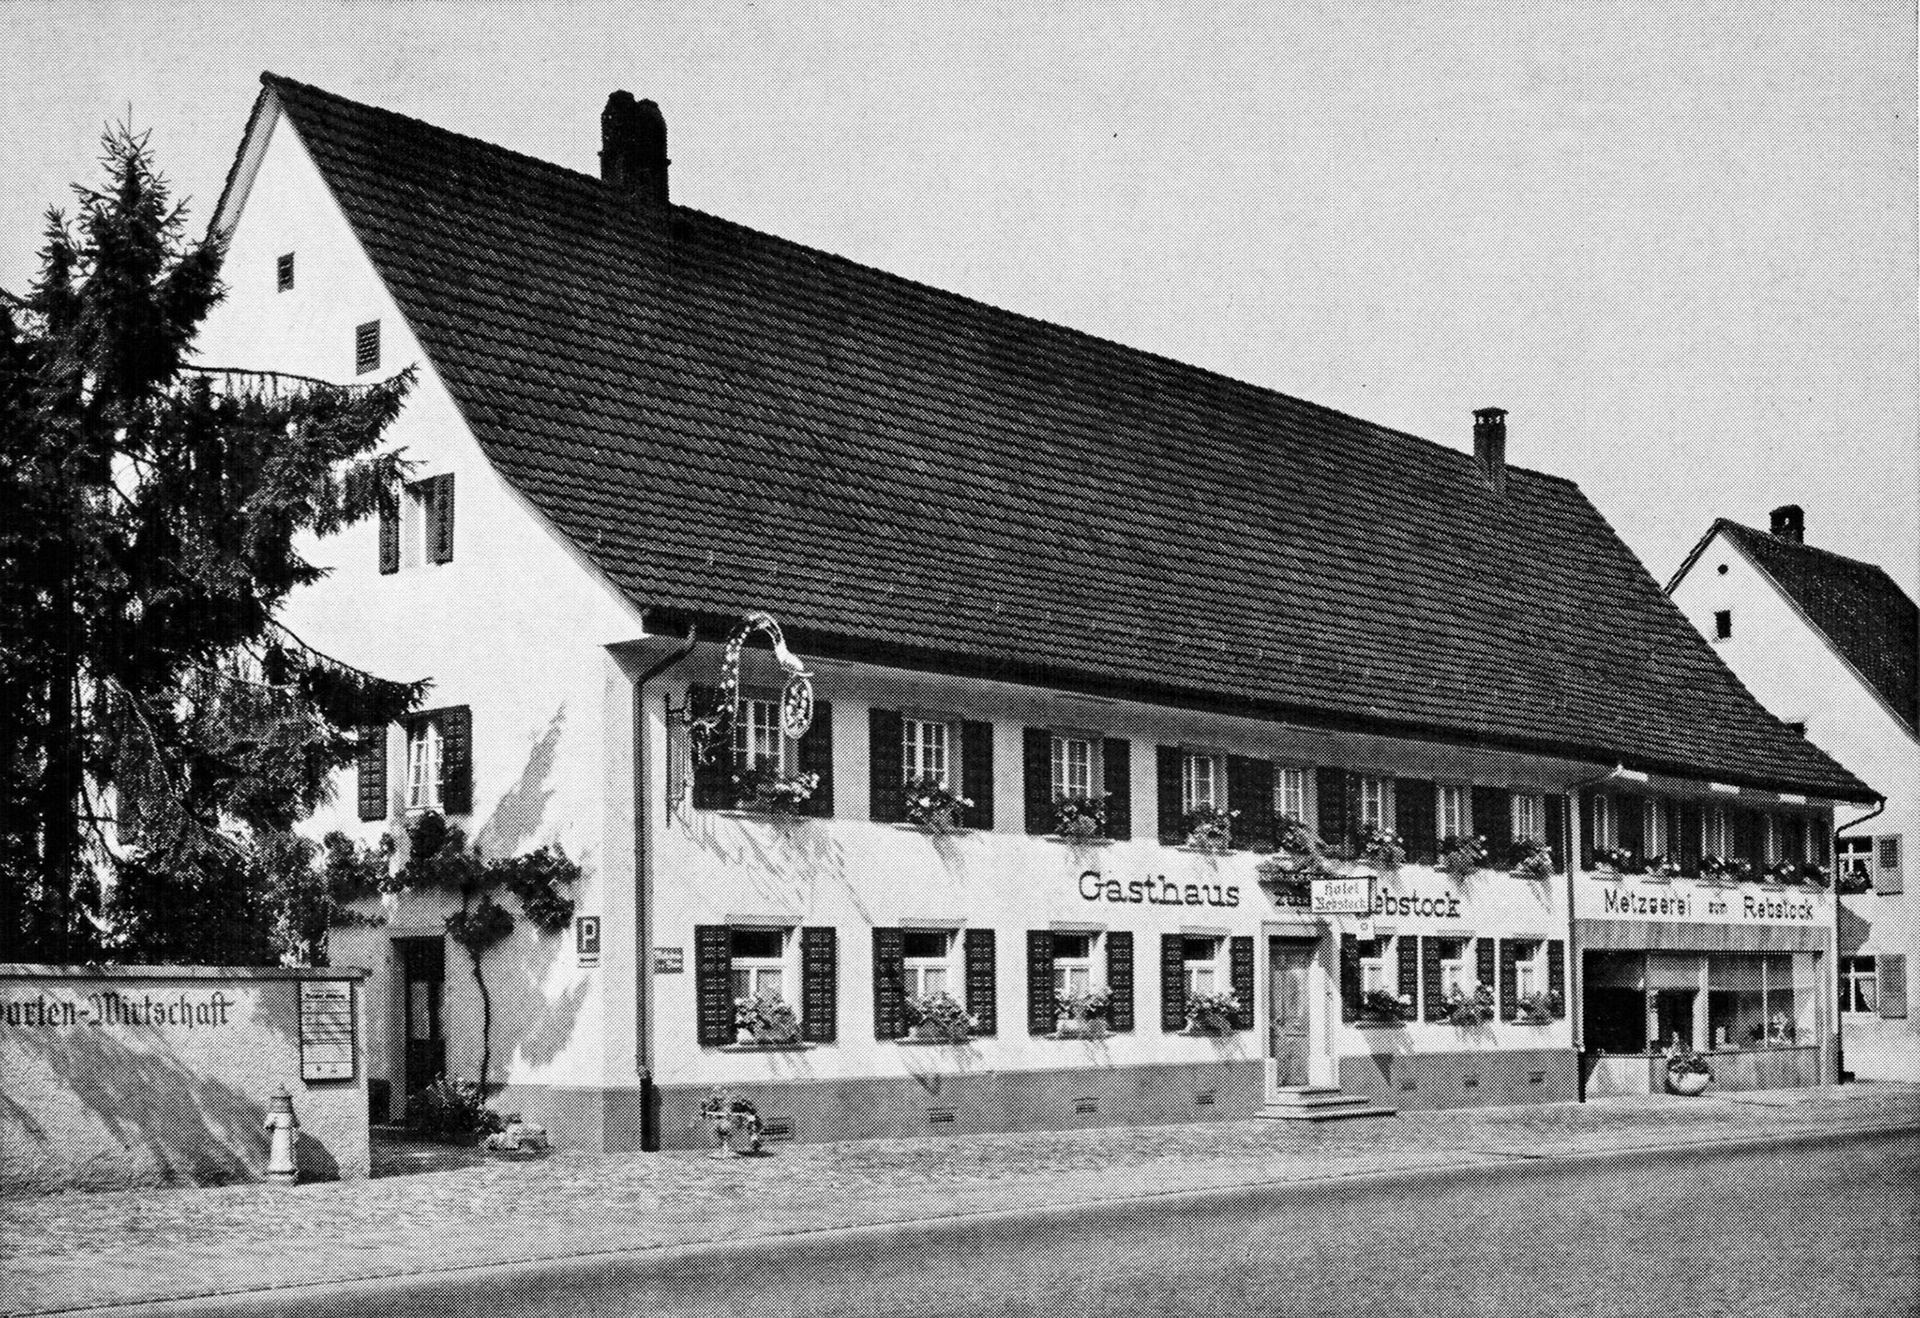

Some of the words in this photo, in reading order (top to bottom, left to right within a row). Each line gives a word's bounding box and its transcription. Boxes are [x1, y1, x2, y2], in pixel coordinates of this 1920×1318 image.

[1078, 870, 1240, 907] Gasthaus
[1375, 888, 1461, 918] ebstock
[1324, 881, 1359, 896] Hotel
[1604, 888, 1692, 916] Metzgerei
[1708, 900, 1728, 914] zum
[1743, 895, 1814, 920] Rebstock
[582, 920, 597, 950] P
[0, 991, 235, 1029] arten-Wirtschaft
